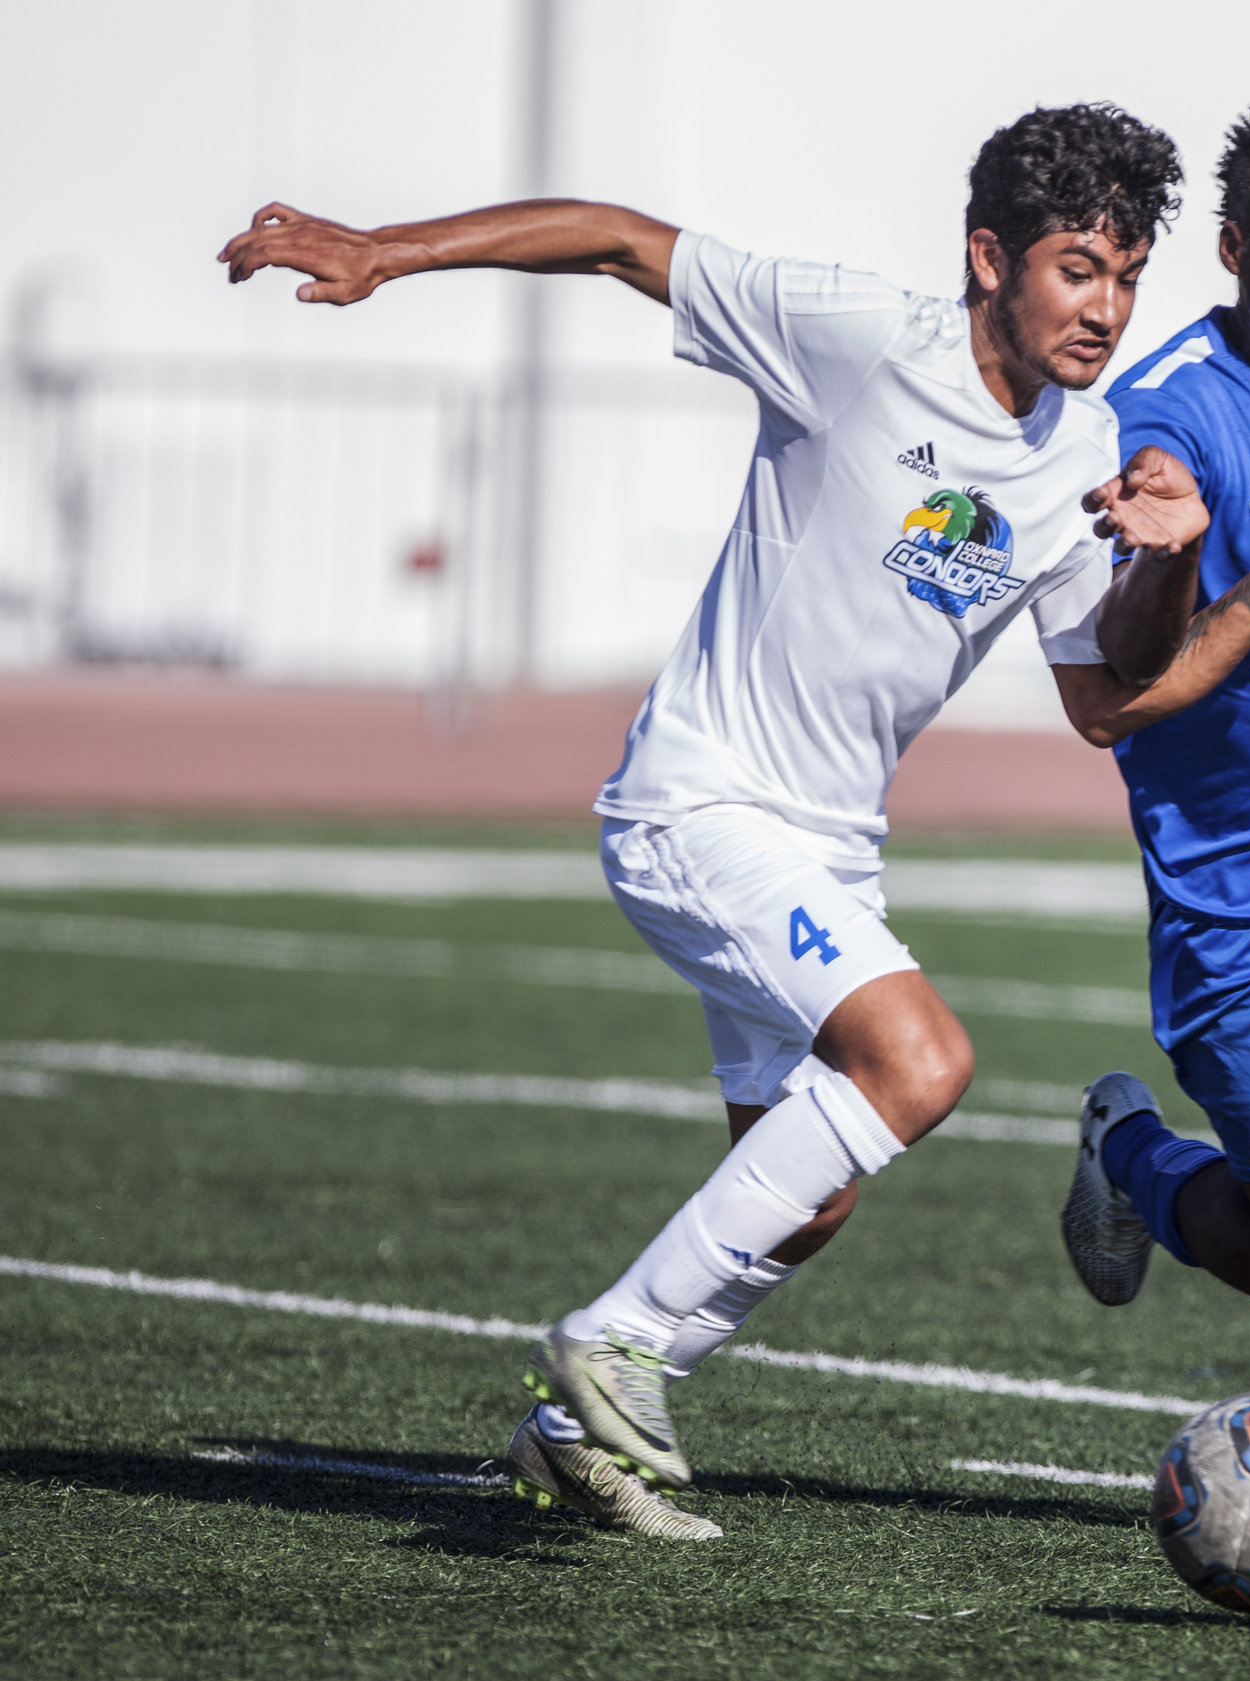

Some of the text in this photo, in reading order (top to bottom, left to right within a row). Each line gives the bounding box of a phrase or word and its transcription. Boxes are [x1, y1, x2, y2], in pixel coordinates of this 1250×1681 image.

[897, 453, 940, 480] adidas
[958, 550, 1004, 571] COLLEGE
[964, 541, 1010, 562] OXNARD
[884, 539, 1025, 605] CONDORS
[790, 905, 842, 966] 4
